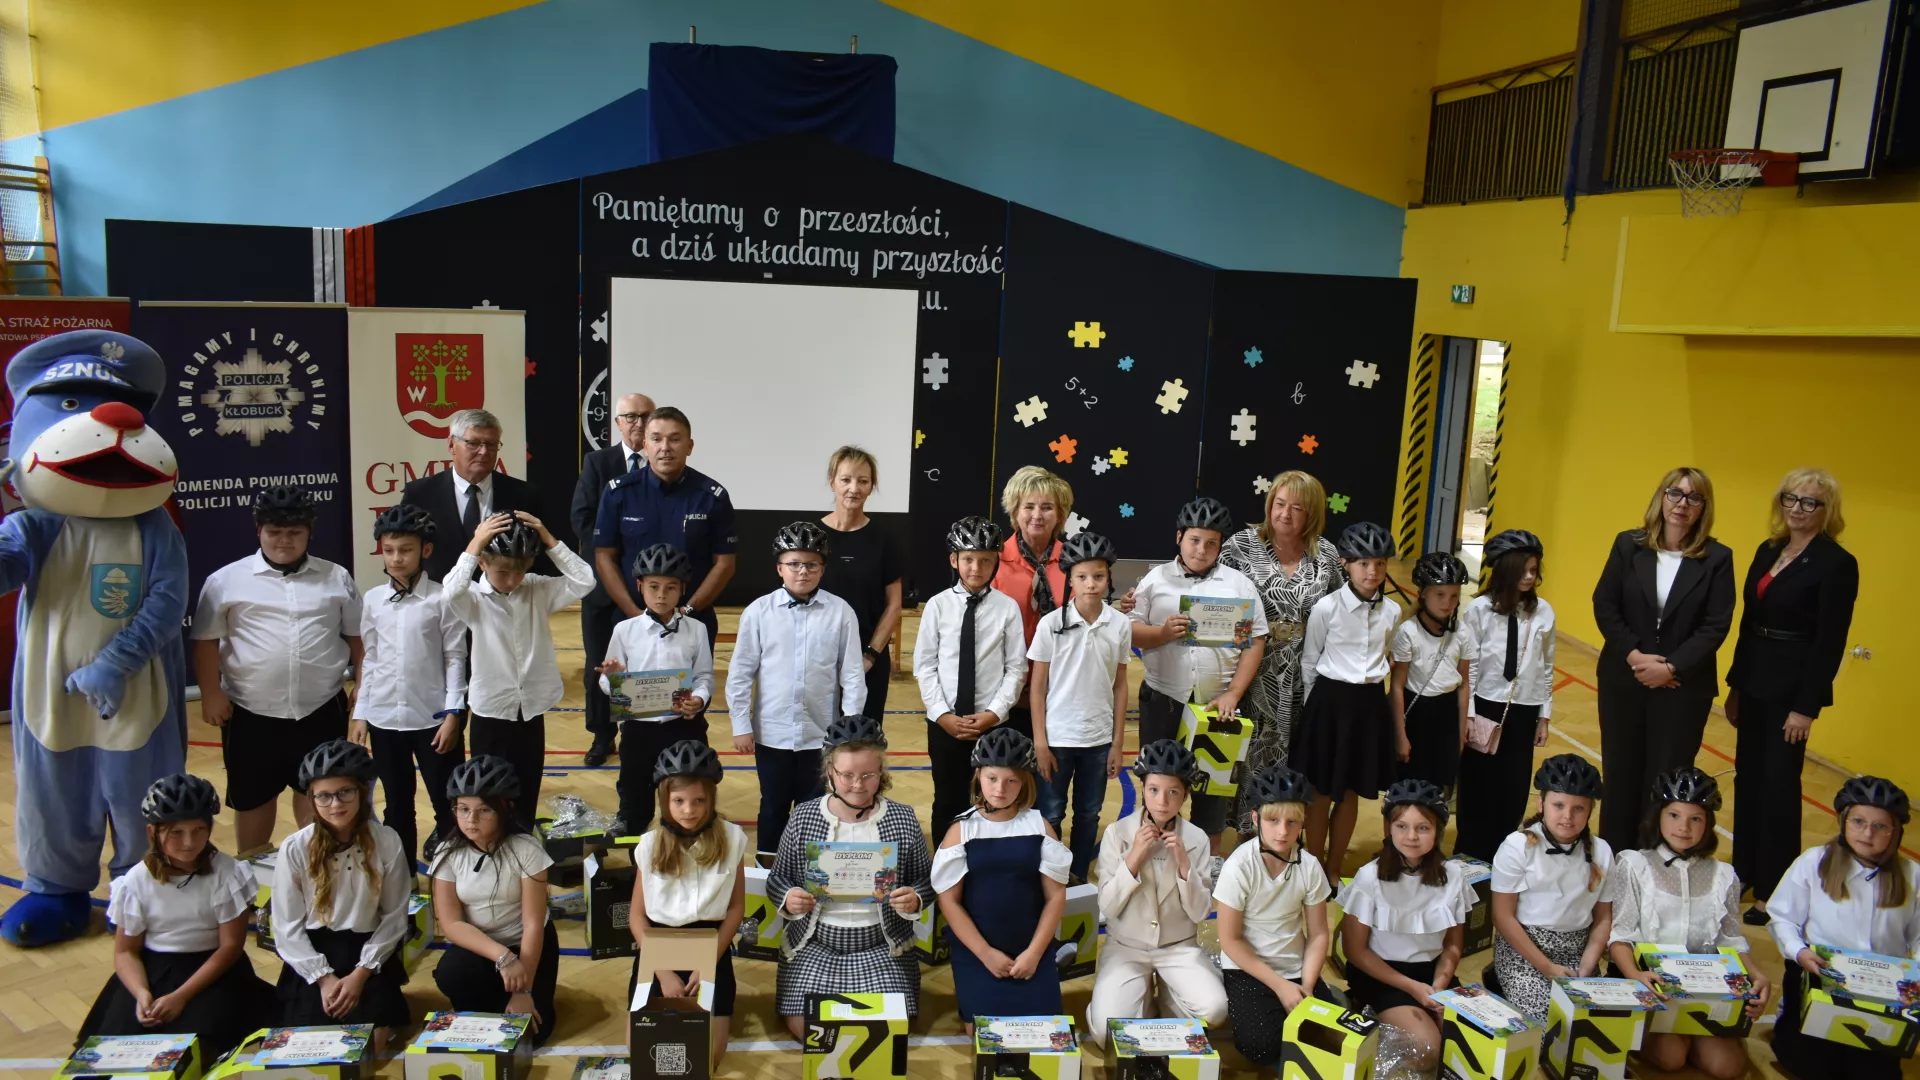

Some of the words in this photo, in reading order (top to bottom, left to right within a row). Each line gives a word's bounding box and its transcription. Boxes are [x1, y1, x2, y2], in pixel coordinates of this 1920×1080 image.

[593, 192, 744, 233] Pamiętamy
[763, 207, 780, 227] o
[799, 206, 950, 239] przeszłości,
[632, 237, 650, 258] a
[660, 232, 717, 261] dziś
[728, 236, 859, 276] układamy
[872, 245, 1004, 279] przyszłość
[8, 316, 50, 328] STRAŻ
[53, 317, 113, 328] POŻARNA
[177, 331, 233, 437] POMAGAMY
[272, 332, 326, 430] CHRONIMY
[224, 375, 283, 385] POLICJA
[407, 385, 427, 403] W
[225, 406, 283, 416] KŁOBUCK
[250, 472, 339, 488] POWIATOWA
[834, 851, 874, 860] DYPLOM
